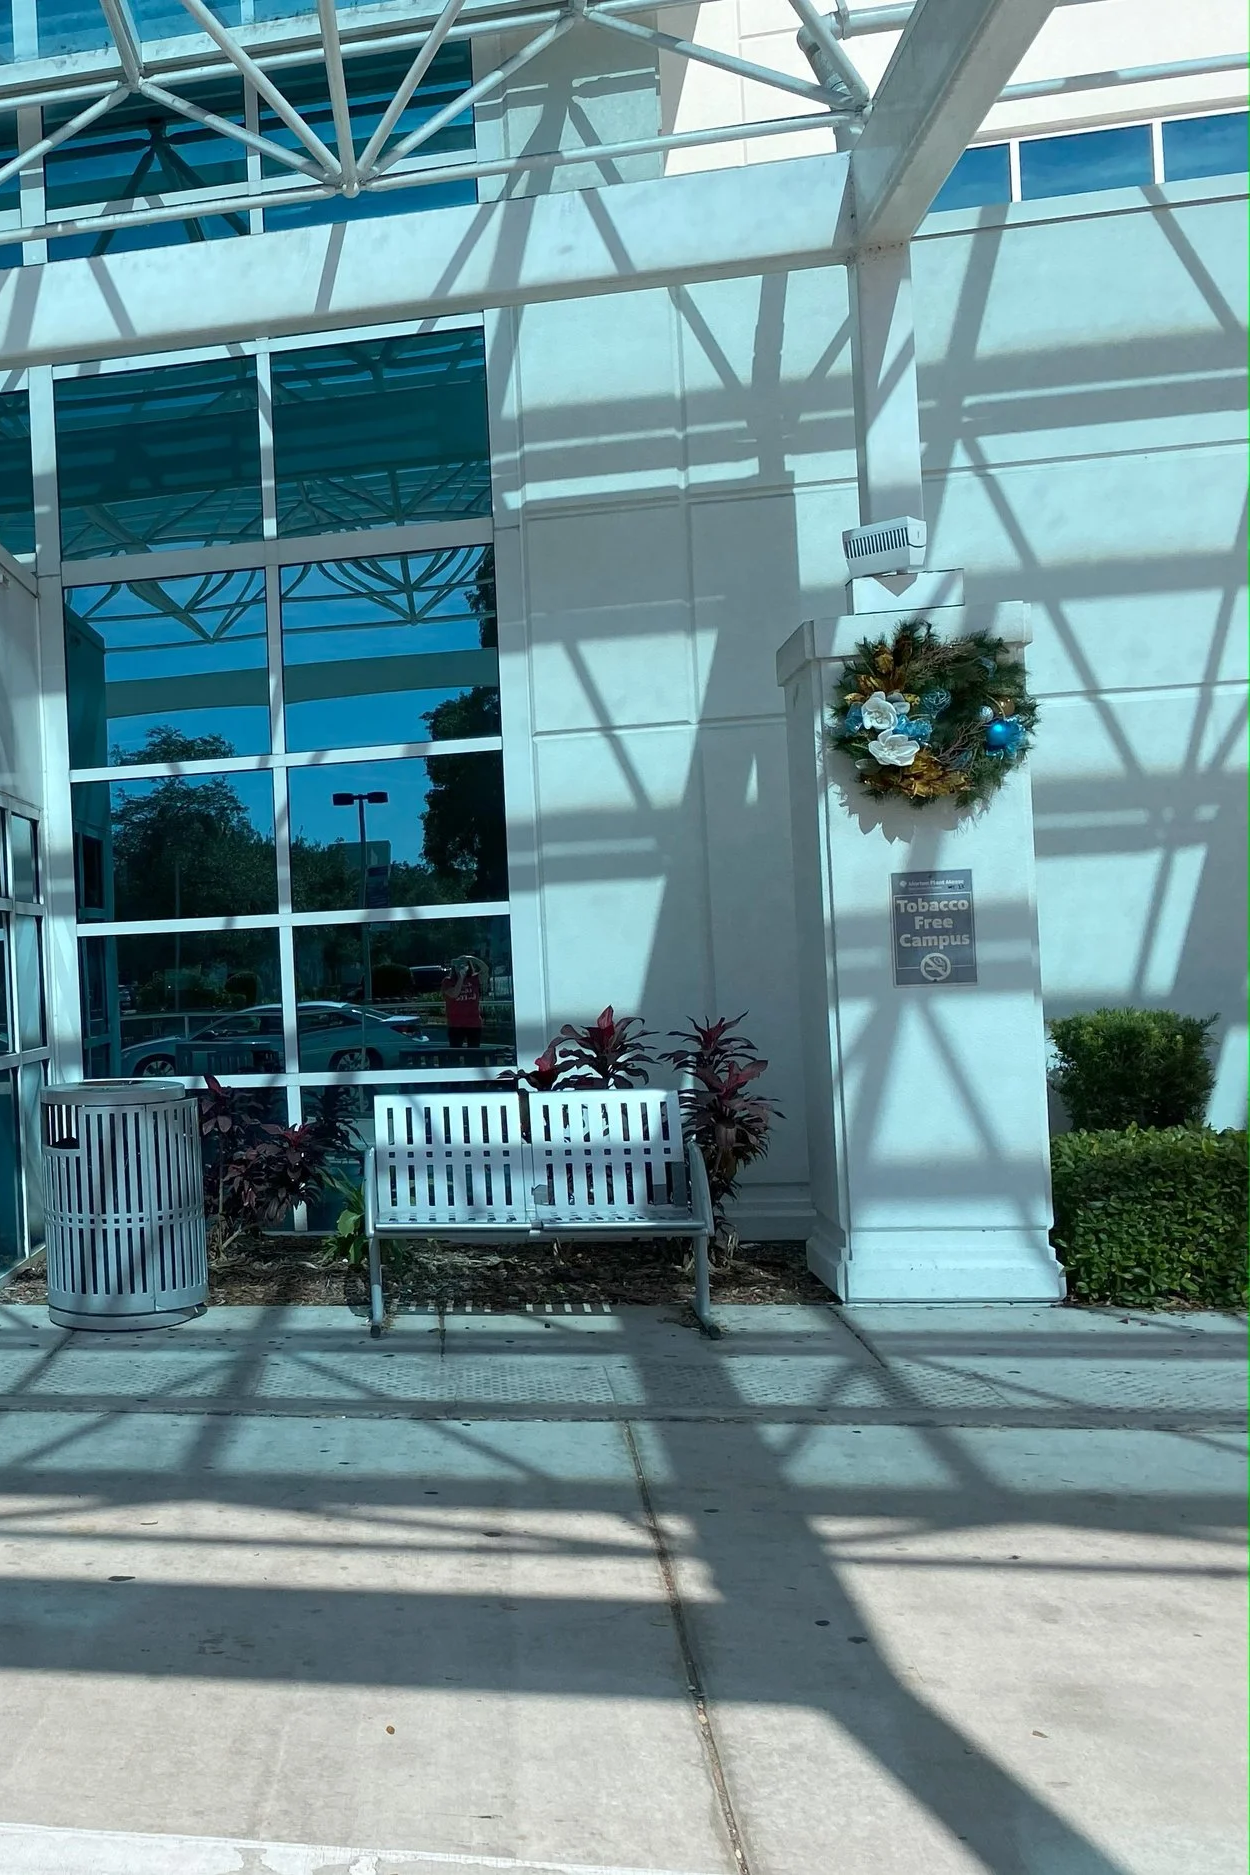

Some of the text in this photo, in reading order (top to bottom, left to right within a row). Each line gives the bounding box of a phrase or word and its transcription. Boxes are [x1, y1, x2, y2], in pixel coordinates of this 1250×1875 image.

[896, 898, 969, 913] Tobacco
[914, 916, 954, 930] Free
[899, 934, 970, 950] Campus
